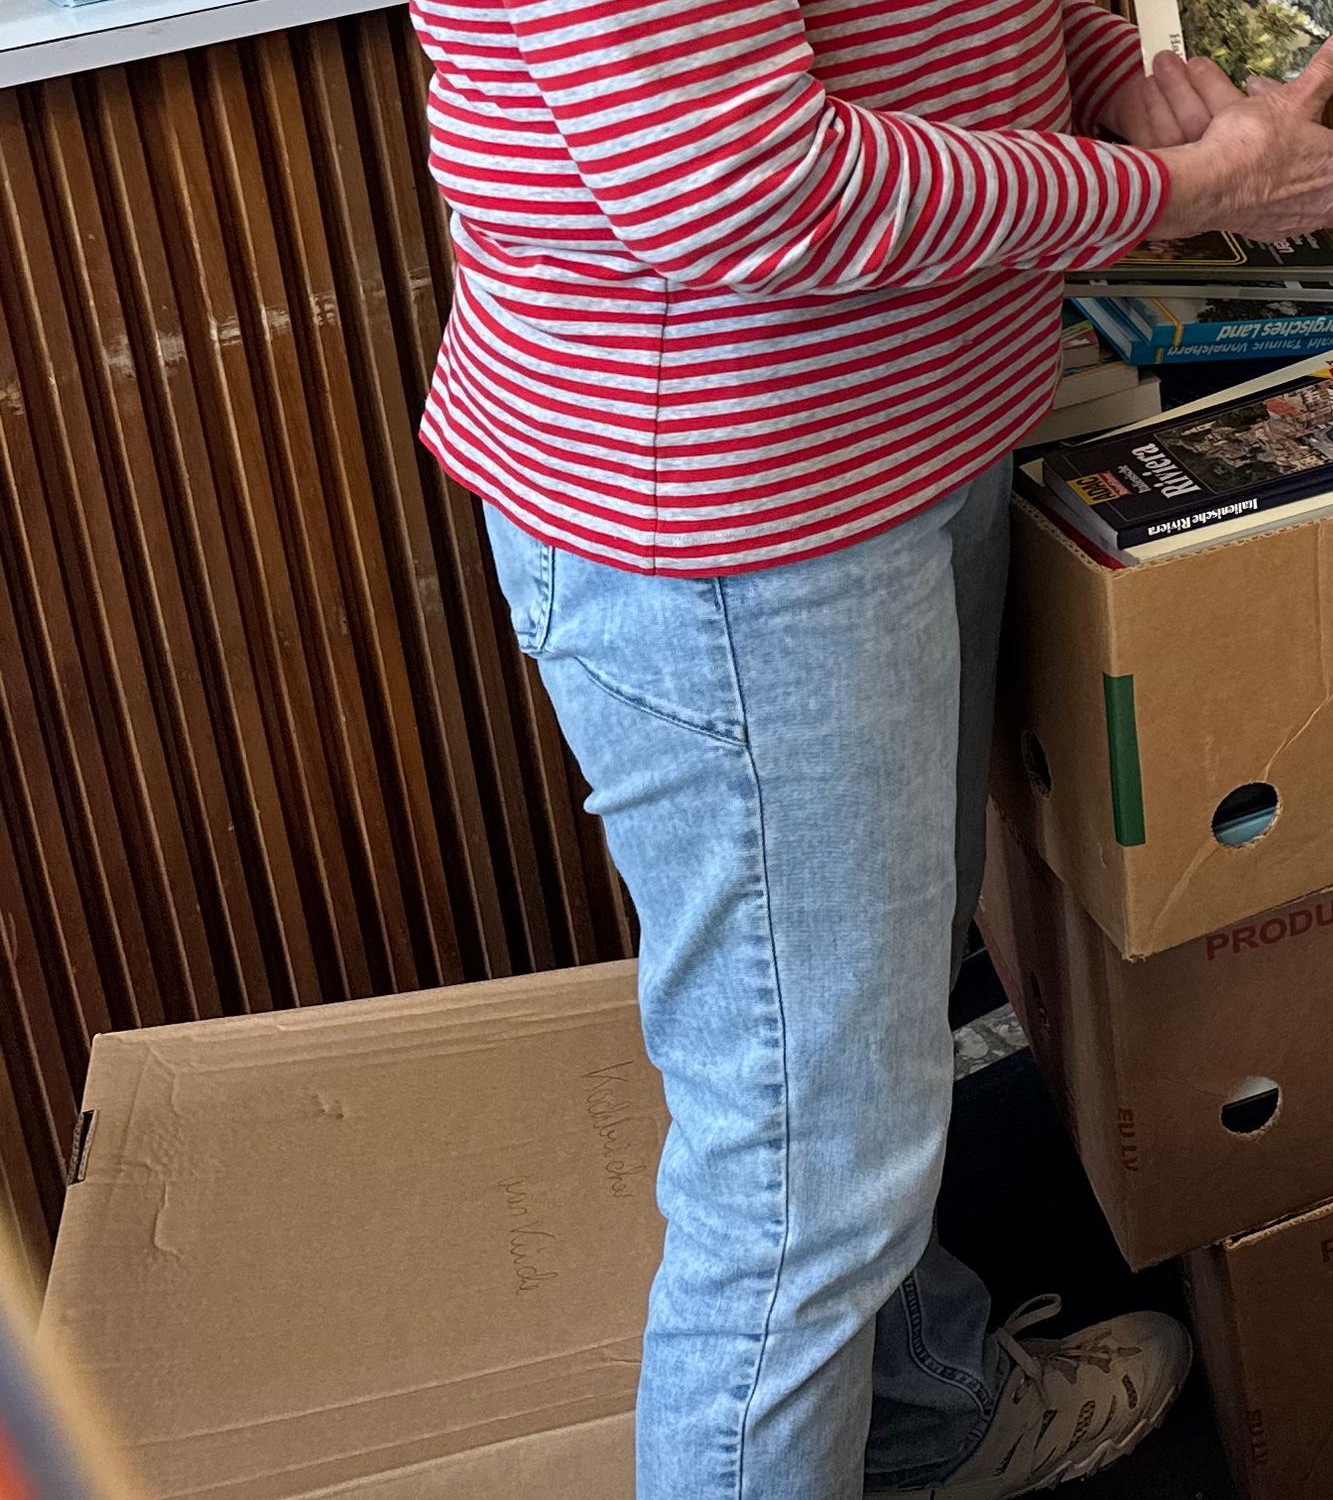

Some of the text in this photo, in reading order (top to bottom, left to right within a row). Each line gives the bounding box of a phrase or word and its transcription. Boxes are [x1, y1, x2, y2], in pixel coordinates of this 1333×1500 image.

[1217, 322, 1262, 341] Land
[1130, 443, 1202, 499] Riviera
[1075, 475, 1118, 502] ADAC
[1147, 498, 1259, 536] Italienische Riviera
